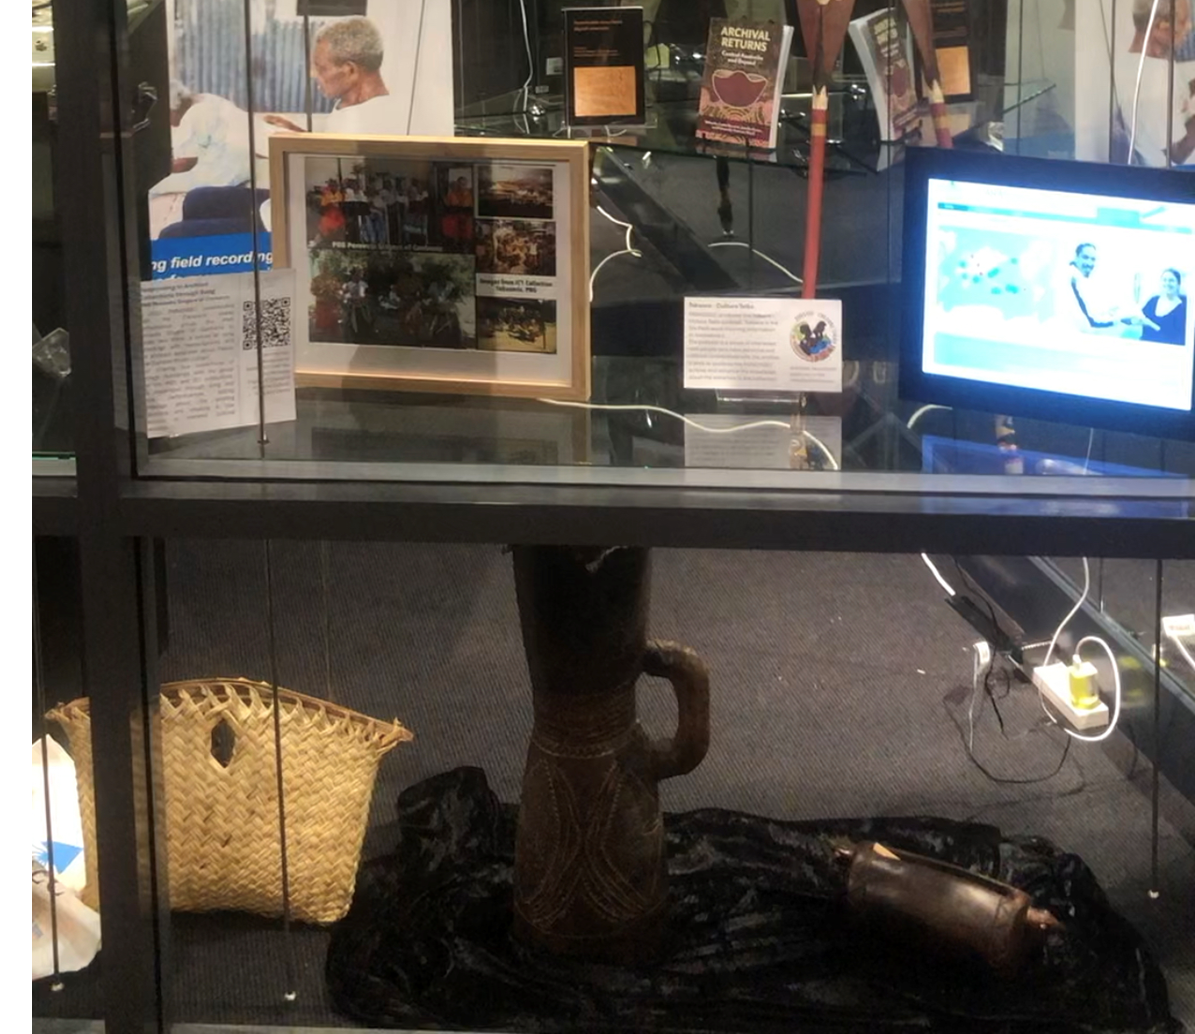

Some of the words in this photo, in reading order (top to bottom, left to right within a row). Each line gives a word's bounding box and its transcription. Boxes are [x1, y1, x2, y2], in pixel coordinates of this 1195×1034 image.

[721, 27, 770, 41] ARCHIVAL
[721, 37, 767, 52] RETURNS
[170, 256, 202, 269] field
[206, 252, 273, 266] recordng
